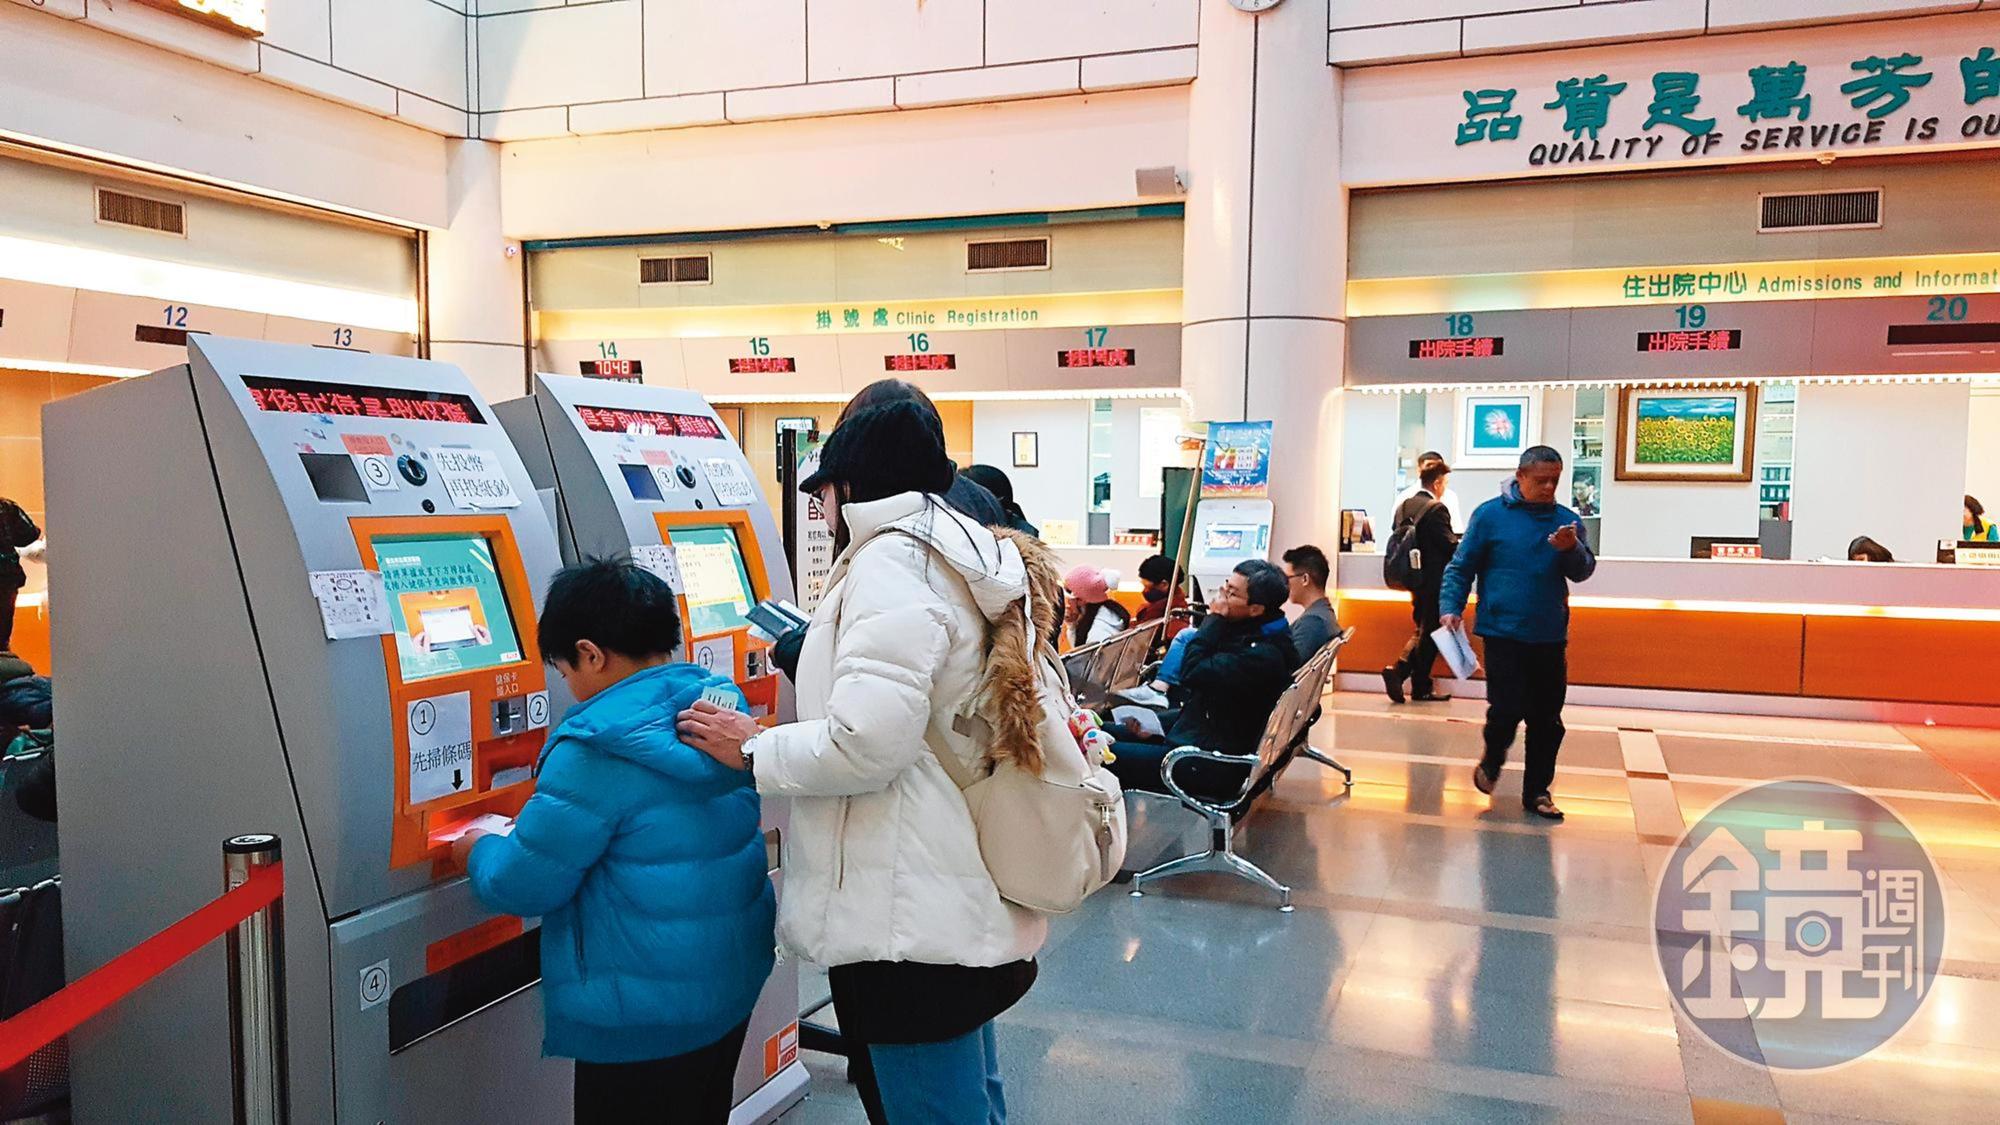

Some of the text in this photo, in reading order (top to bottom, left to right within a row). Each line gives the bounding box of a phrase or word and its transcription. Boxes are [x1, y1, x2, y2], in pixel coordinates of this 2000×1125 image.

[1529, 135, 1663, 166] QUALITY
[1682, 132, 1724, 156] OF
[1740, 120, 1886, 151] SERVICE
[1905, 116, 1940, 141] IS
[1622, 270, 1748, 298] 住出院中心
[1757, 268, 1998, 293] Admissions and Informat
[163, 306, 188, 327] 12
[816, 308, 889, 329] 掛號處
[896, 308, 1039, 326] Clinic Registration
[1675, 305, 1706, 328] 19
[1927, 296, 1969, 321] 20
[1445, 313, 1474, 336] 18
[333, 328, 352, 346] 13
[749, 337, 770, 355] 15
[907, 332, 930, 352] 16
[1085, 327, 1109, 347] 17
[1419, 337, 1495, 358] 出院手續
[1648, 330, 1731, 351] 出院手續
[598, 341, 618, 359] 14
[412, 740, 472, 775] 先掃條碼
